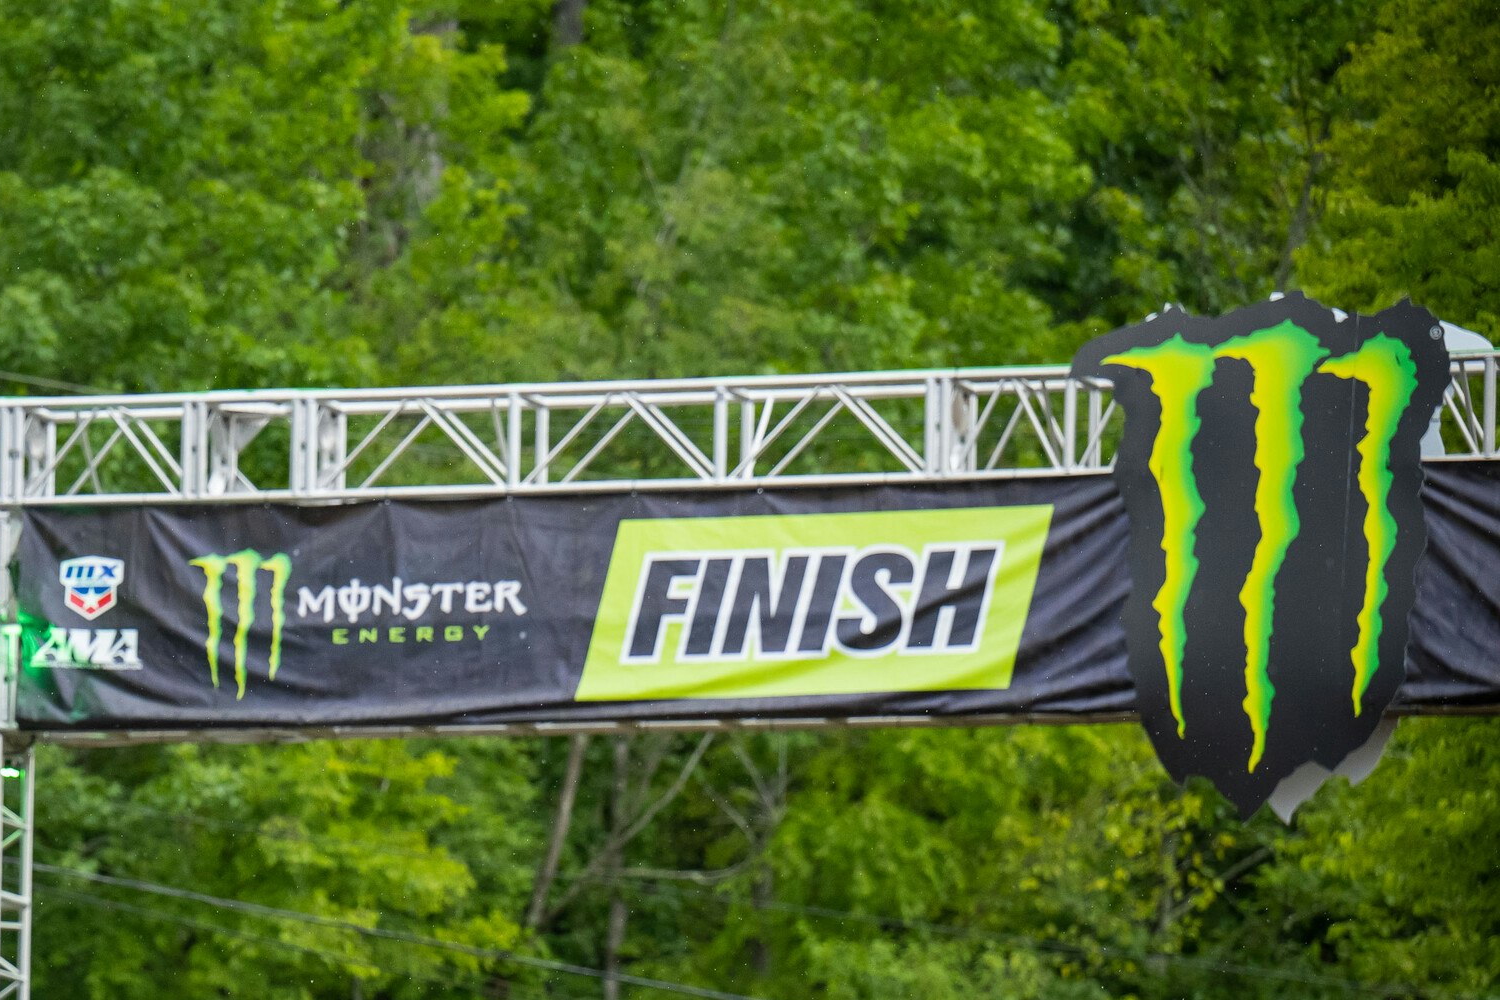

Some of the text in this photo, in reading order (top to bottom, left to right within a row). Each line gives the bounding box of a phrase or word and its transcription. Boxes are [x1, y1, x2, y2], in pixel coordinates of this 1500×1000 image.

[297, 577, 528, 622] MONSTER
[619, 540, 1006, 665] FINISH
[32, 627, 142, 669] AMA
[332, 625, 491, 646] ENERGY
